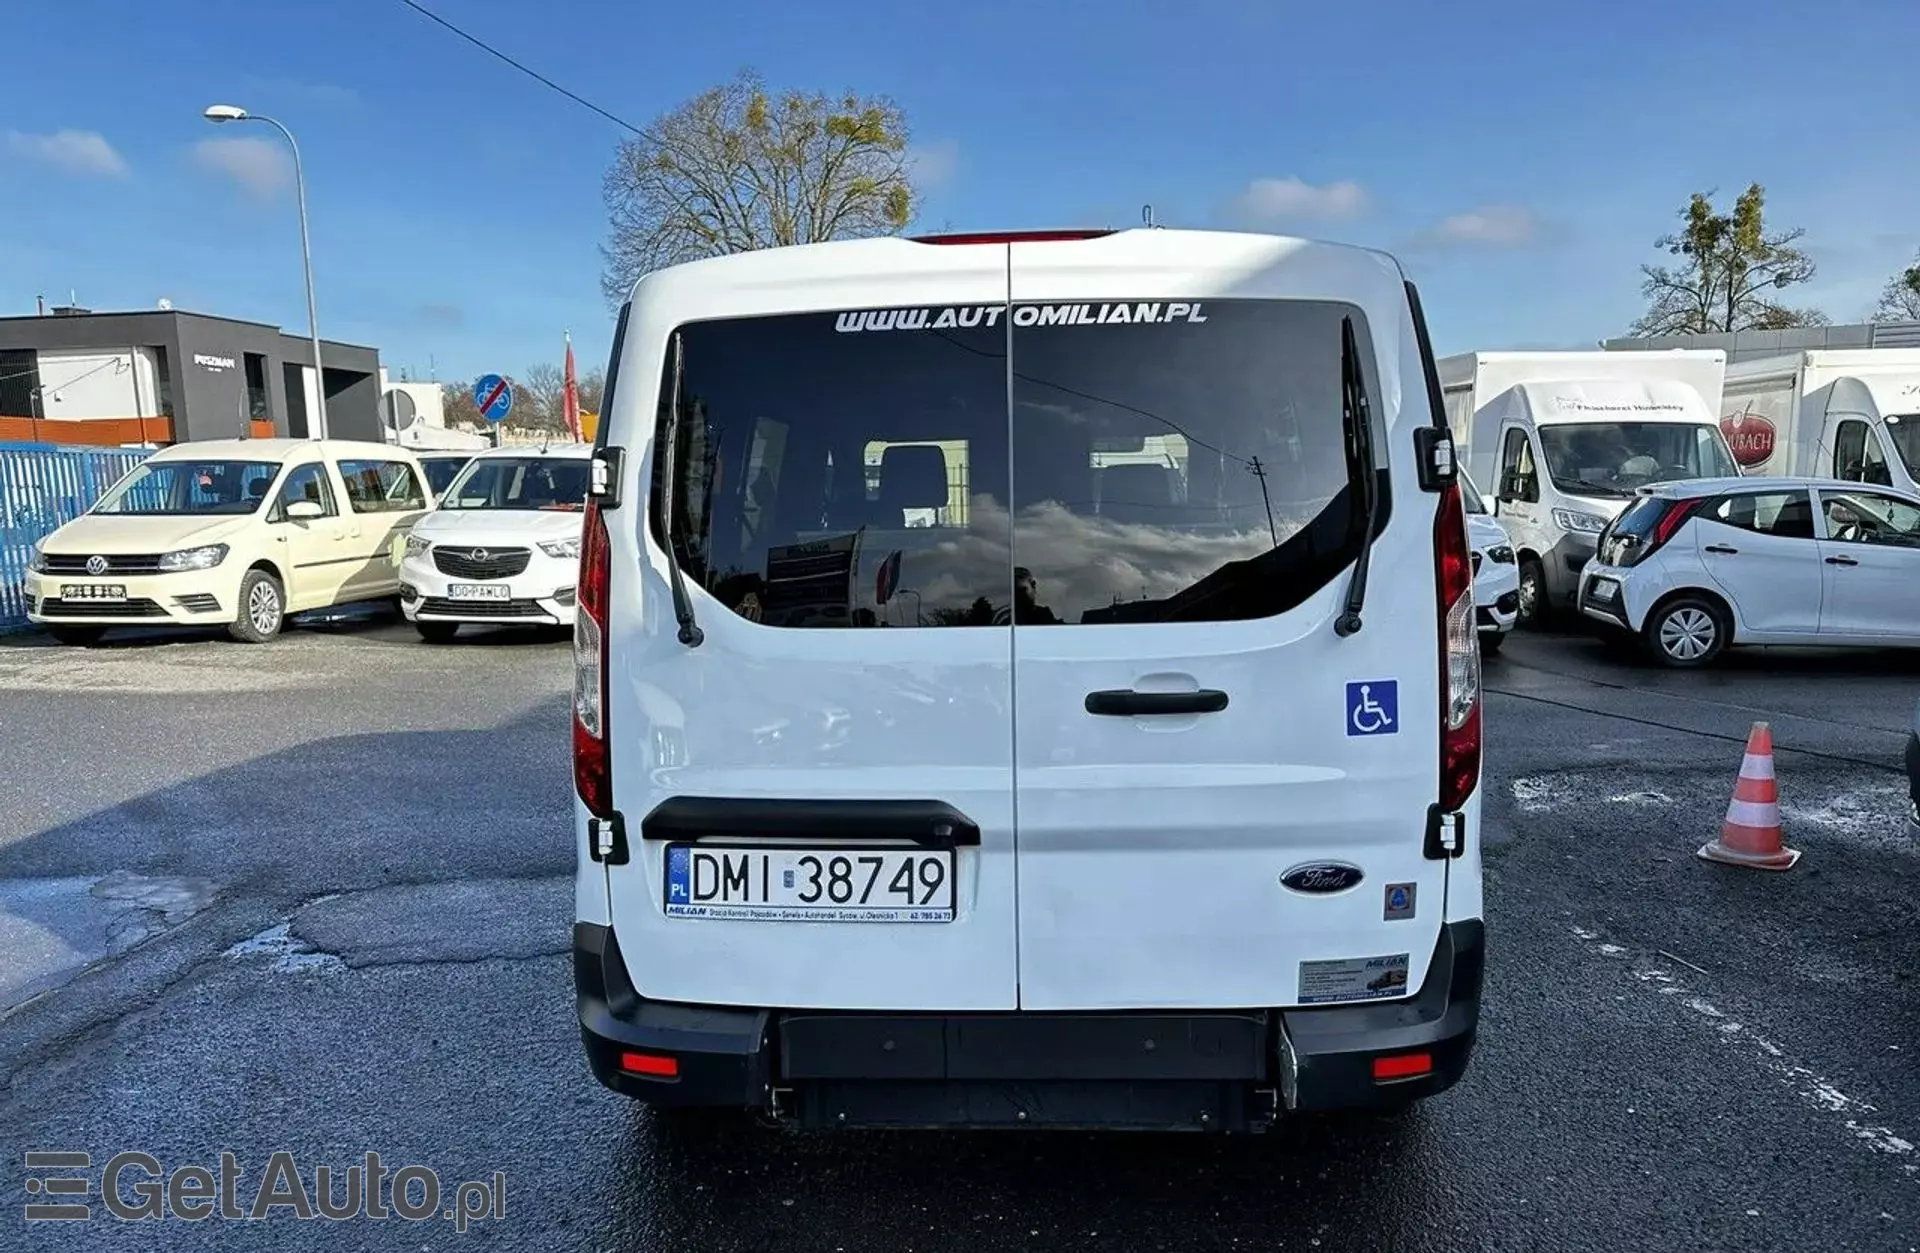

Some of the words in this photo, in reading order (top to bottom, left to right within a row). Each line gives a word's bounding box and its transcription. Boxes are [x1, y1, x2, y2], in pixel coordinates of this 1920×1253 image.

[693, 854, 769, 902] DMI
[798, 856, 945, 905] 38749
[1301, 868, 1347, 888] Ford
[671, 884, 688, 897] PL
[668, 906, 706, 915] MILIAN
